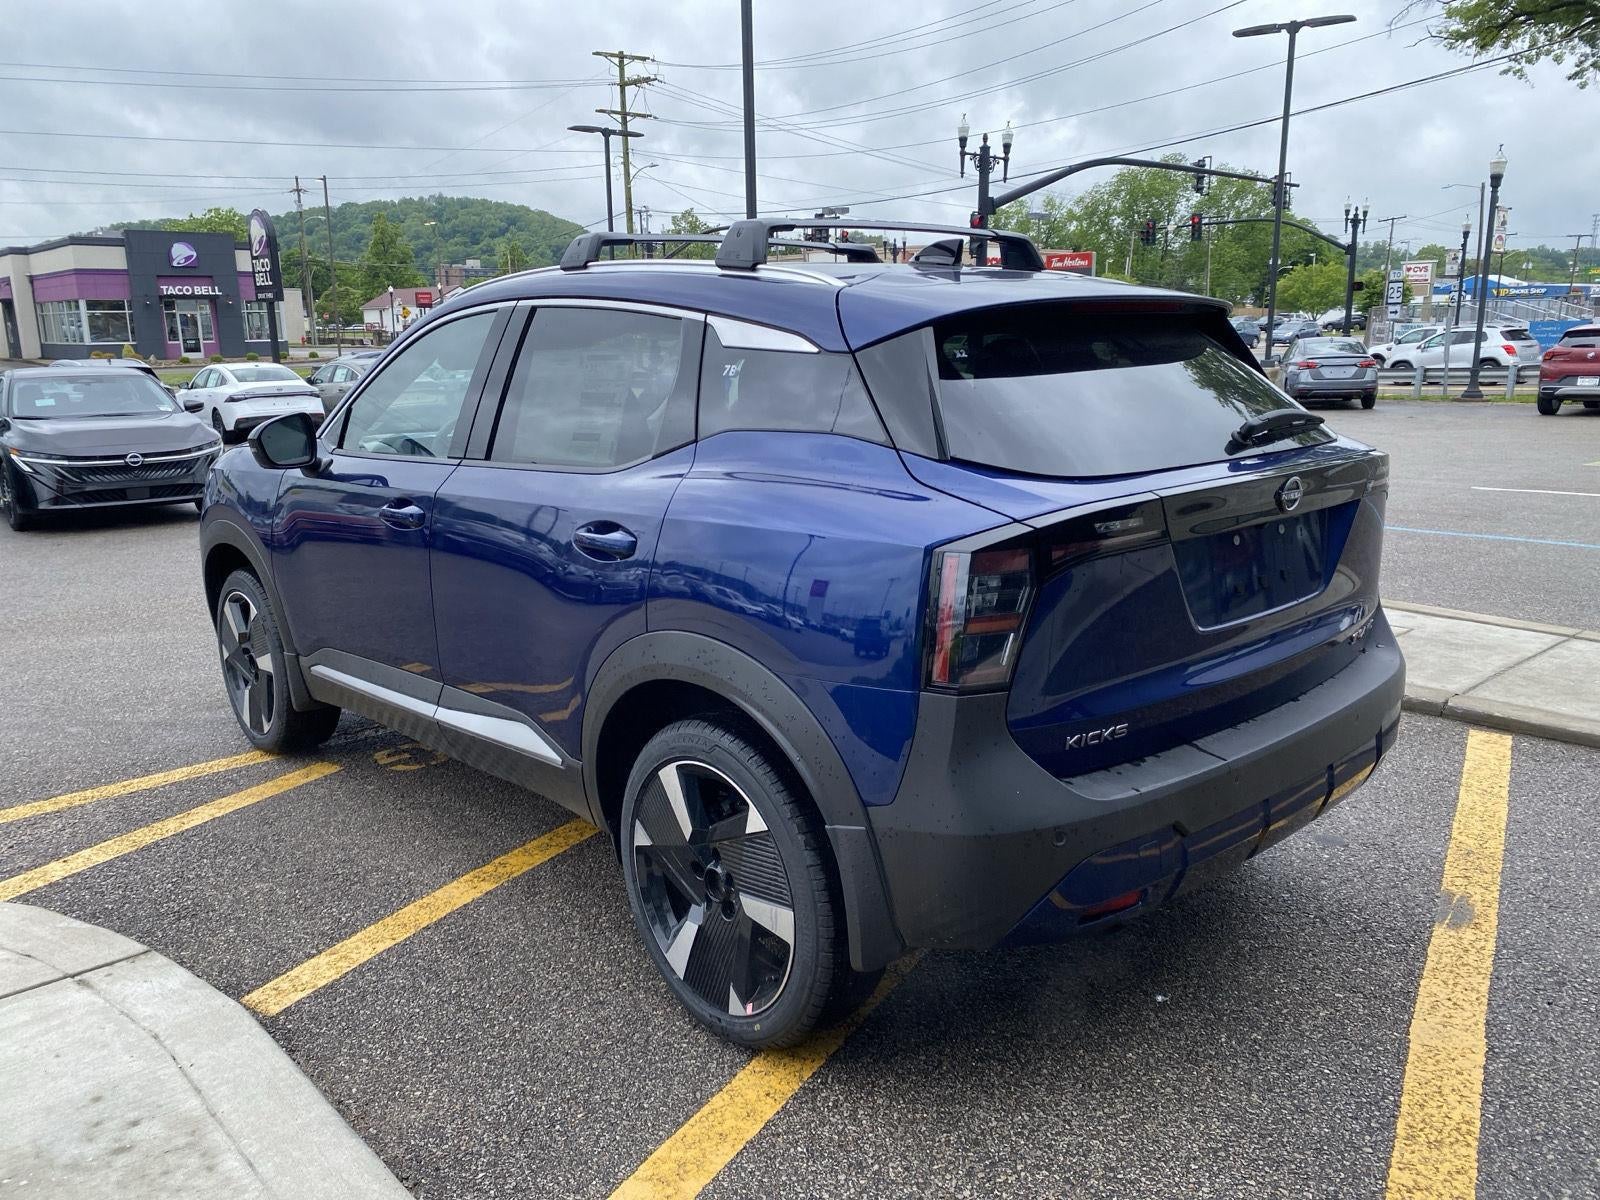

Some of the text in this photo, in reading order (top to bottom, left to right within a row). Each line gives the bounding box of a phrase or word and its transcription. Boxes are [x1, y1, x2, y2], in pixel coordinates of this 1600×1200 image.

[252, 258, 271, 272] TACO
[1051, 256, 1088, 268] Tim Hortons
[1412, 265, 1429, 273] CVS
[255, 272, 273, 286] BELL
[160, 285, 223, 295] TACO BELL
[1388, 286, 1402, 299] 25
[1492, 288, 1509, 297] VIP
[1065, 723, 1129, 751] KICKS
